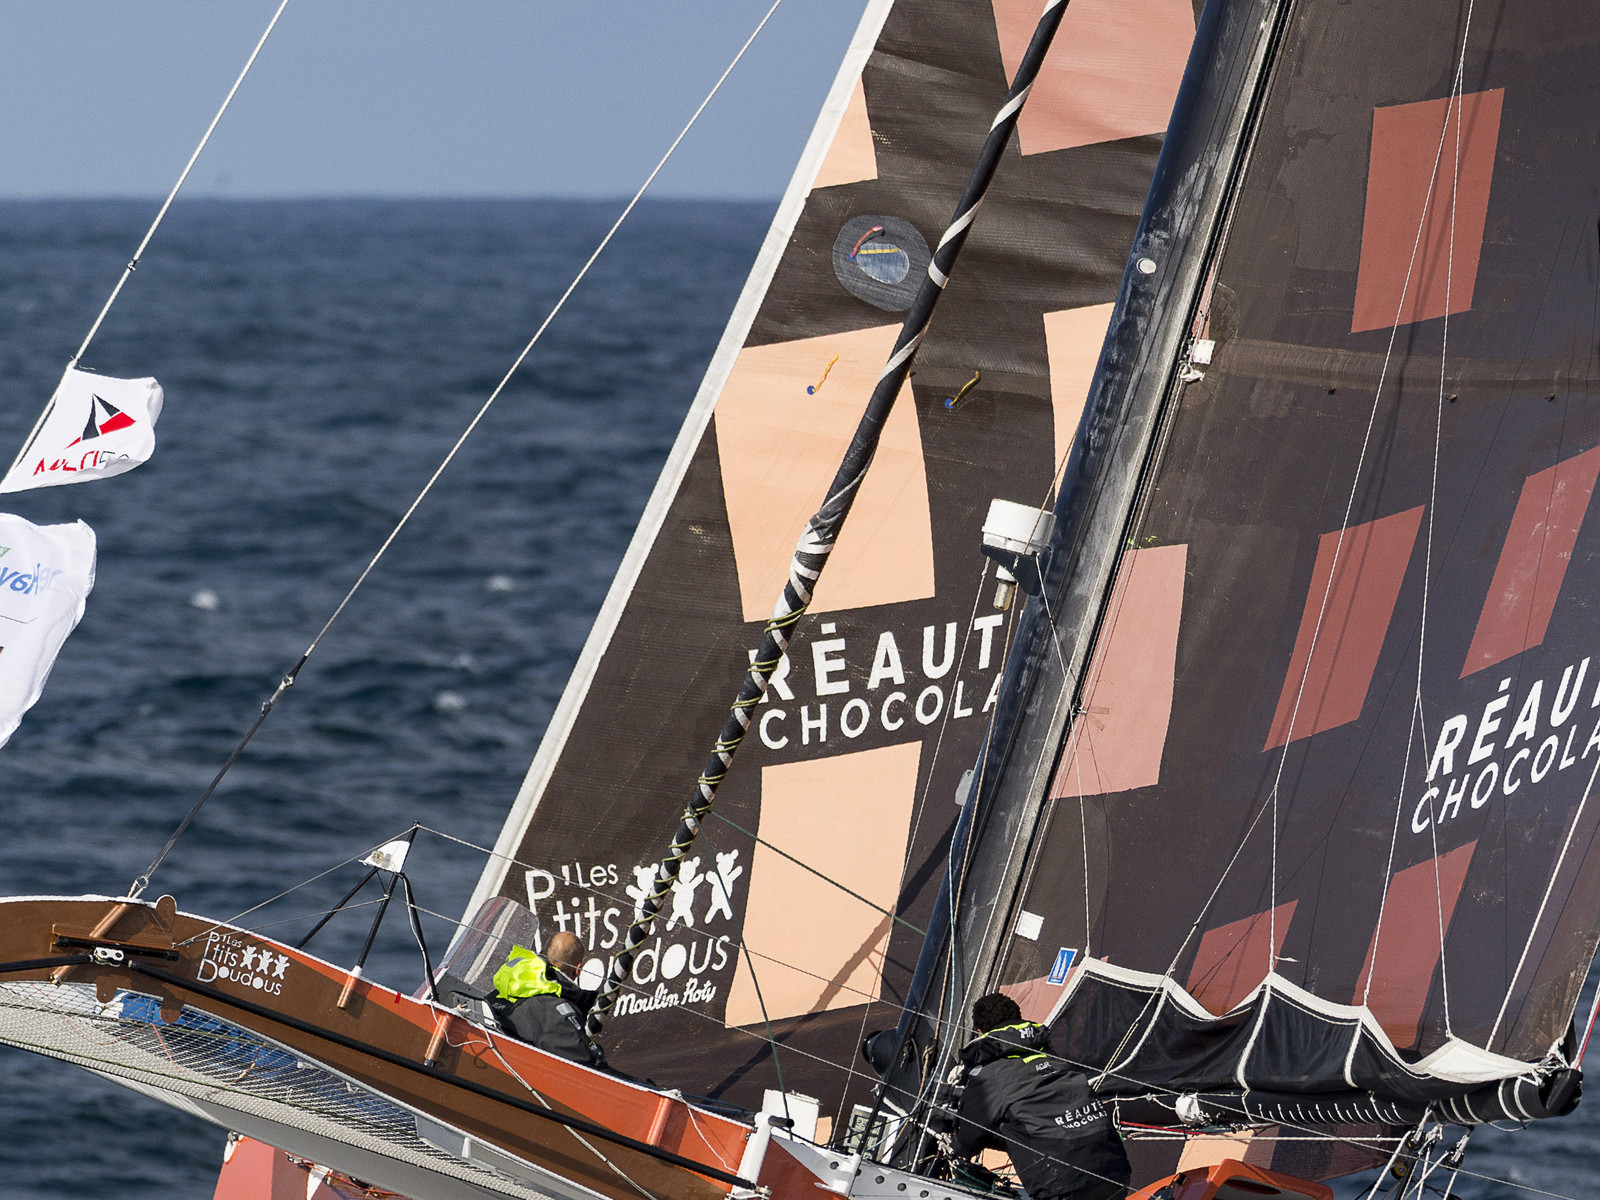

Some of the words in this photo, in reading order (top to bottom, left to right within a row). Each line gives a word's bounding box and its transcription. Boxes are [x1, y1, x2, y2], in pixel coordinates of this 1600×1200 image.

[748, 612, 1004, 704] RÉAUT
[1425, 657, 1600, 783] RÉAU
[197, 958, 282, 995] Doudous
[613, 983, 680, 1017] Moulin
[681, 978, 717, 1006] Roty
